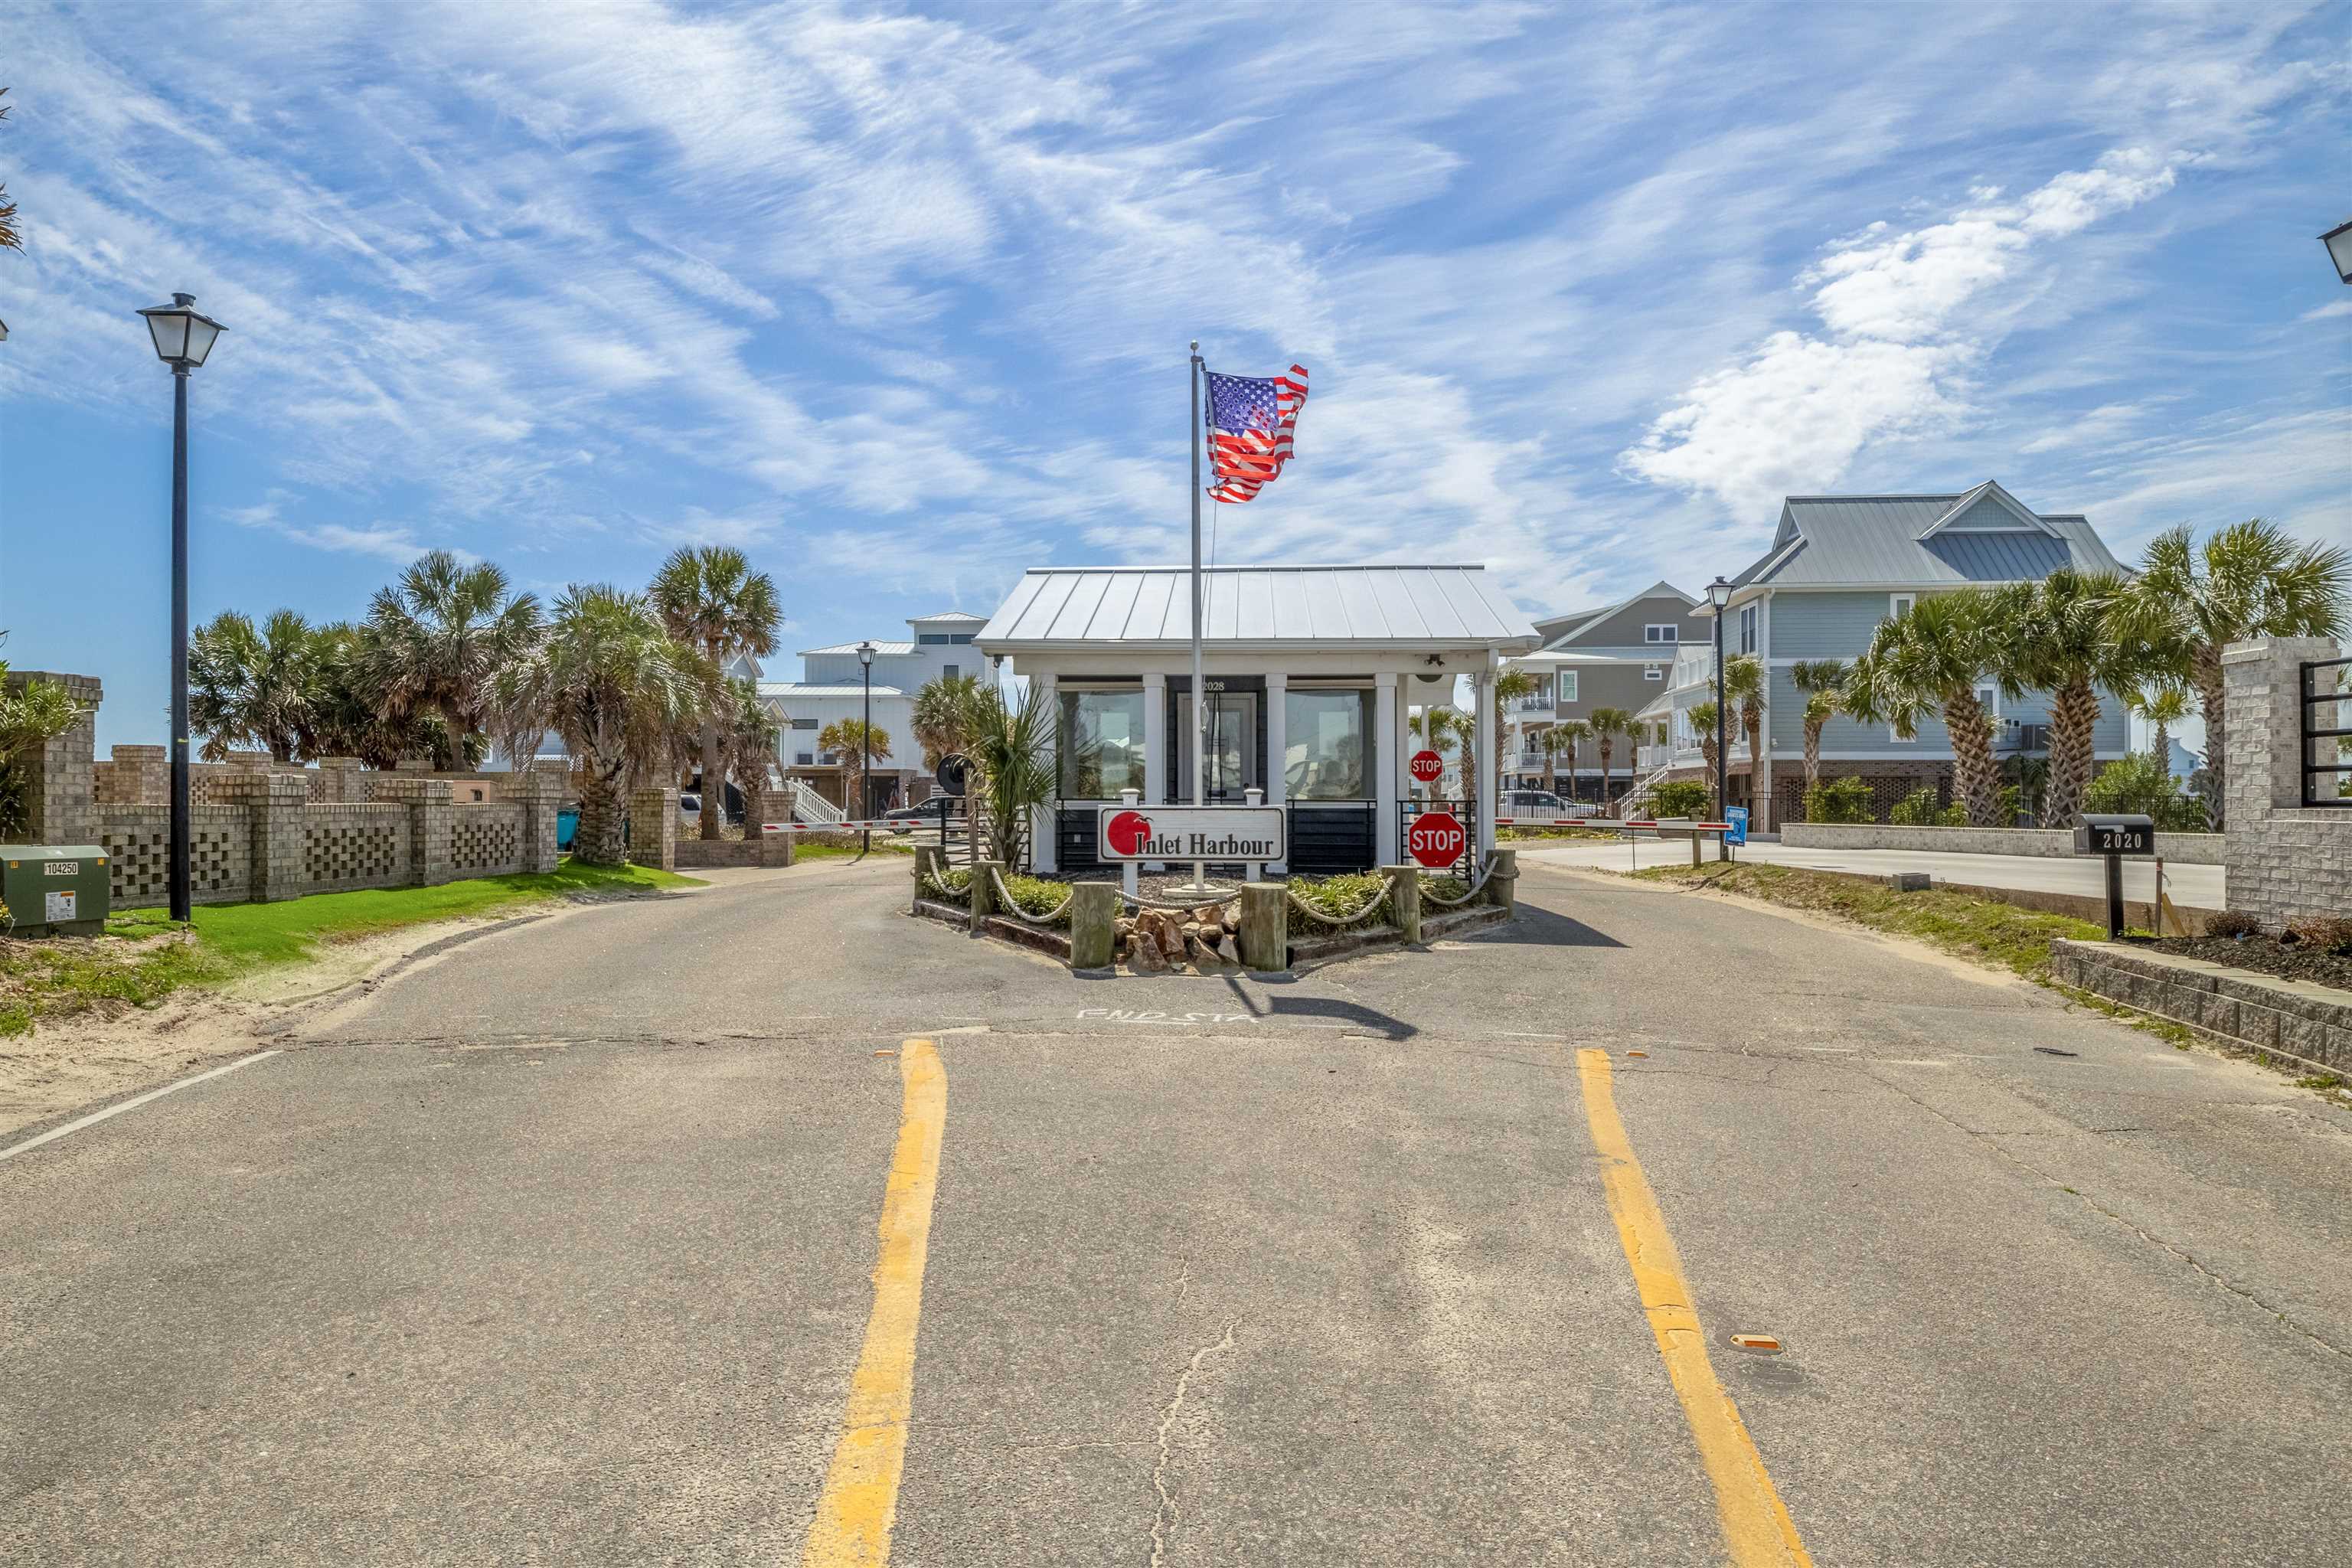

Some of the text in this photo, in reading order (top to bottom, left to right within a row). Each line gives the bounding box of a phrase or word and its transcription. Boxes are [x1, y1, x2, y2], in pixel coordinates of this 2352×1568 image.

[1412, 760, 1441, 773] STOP
[1135, 832, 1274, 855] Inlet Harbour
[1412, 829, 1462, 851] STOP
[2103, 833, 2141, 848] 2020
[47, 863, 77, 874] 104250
